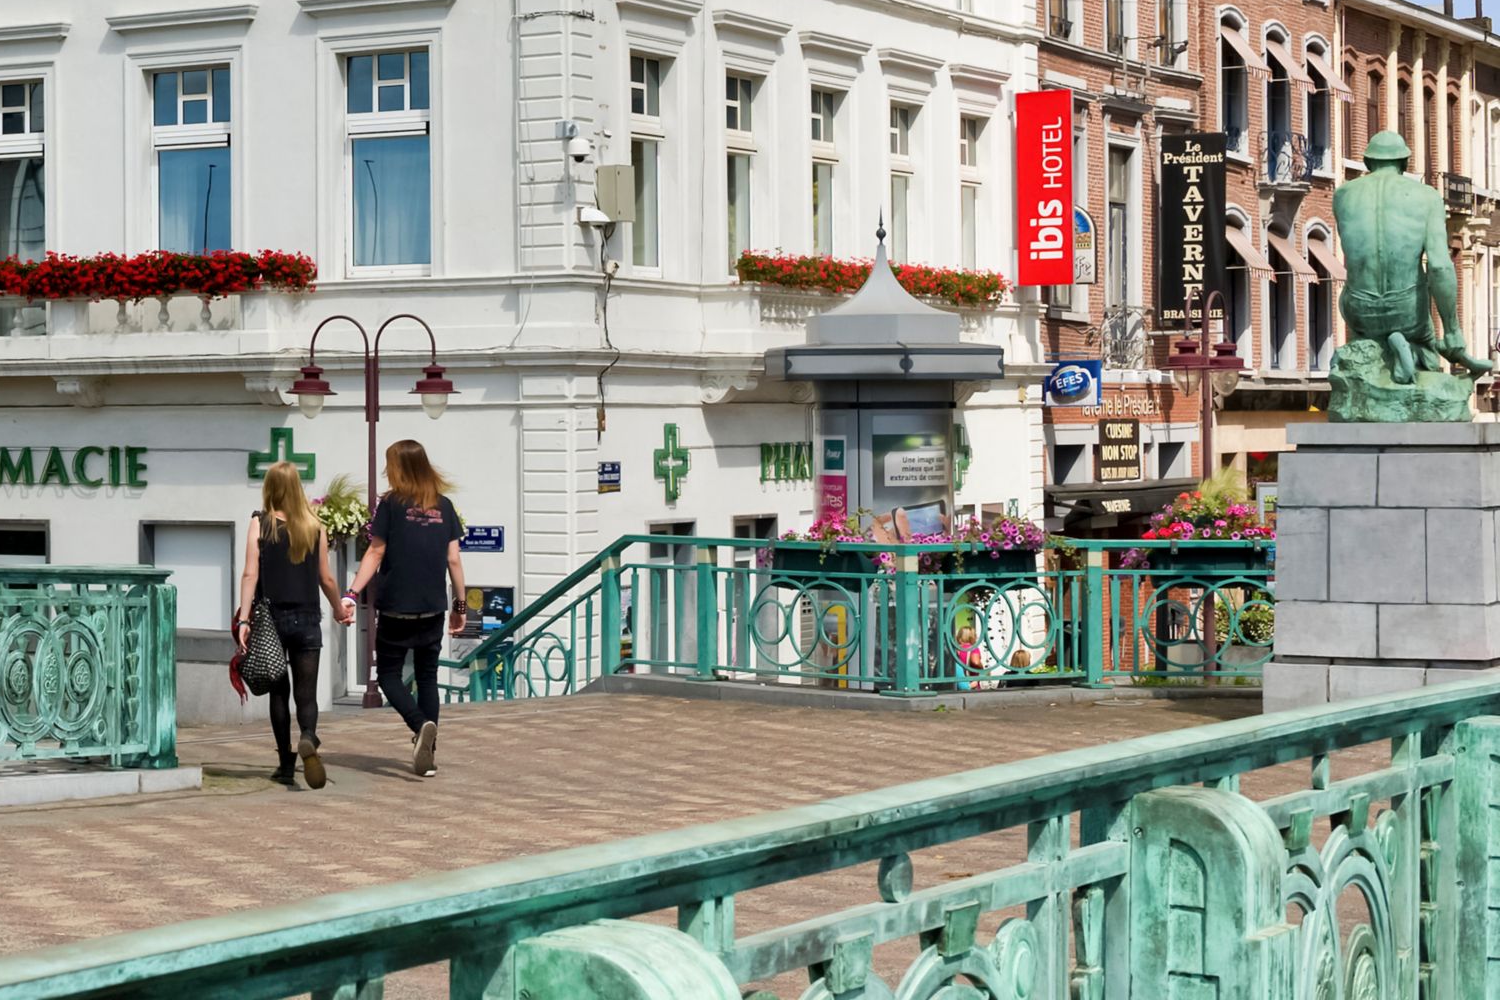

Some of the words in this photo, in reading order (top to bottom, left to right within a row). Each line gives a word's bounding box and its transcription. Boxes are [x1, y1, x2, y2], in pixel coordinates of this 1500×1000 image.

[1042, 116, 1063, 189] HOTEL
[1185, 140, 1201, 152] Le
[1163, 152, 1224, 164] Président
[1029, 199, 1064, 260] ibis
[1182, 166, 1205, 300] TAVERNE
[1163, 309, 1224, 319] BRASIE
[1056, 373, 1083, 389] EFES
[1105, 423, 1133, 439] CUISINE
[1102, 445, 1119, 460] NON
[1120, 444, 1138, 460] STOP
